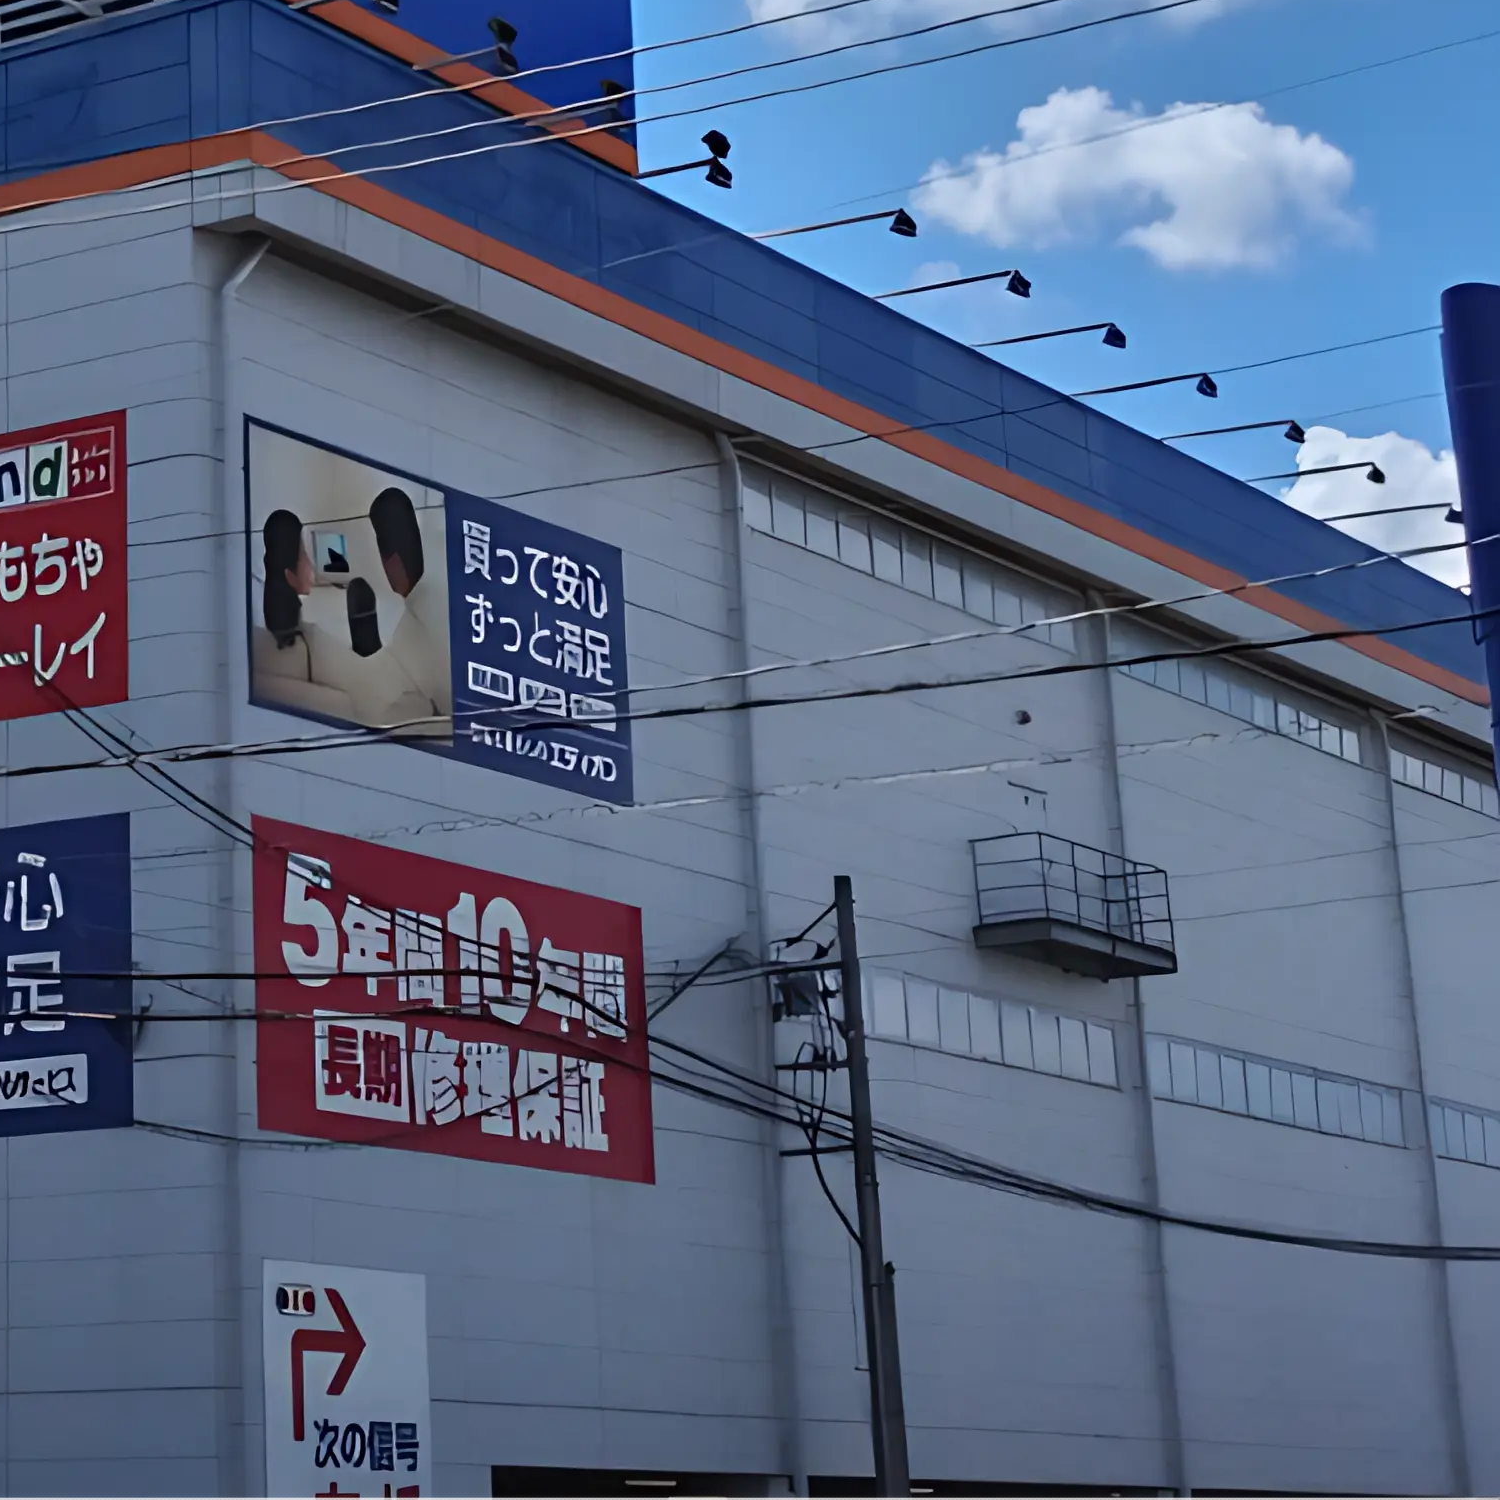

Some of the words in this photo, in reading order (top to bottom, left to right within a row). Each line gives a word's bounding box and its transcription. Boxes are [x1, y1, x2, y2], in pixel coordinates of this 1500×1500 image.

[462, 519, 608, 619] 買って安心
